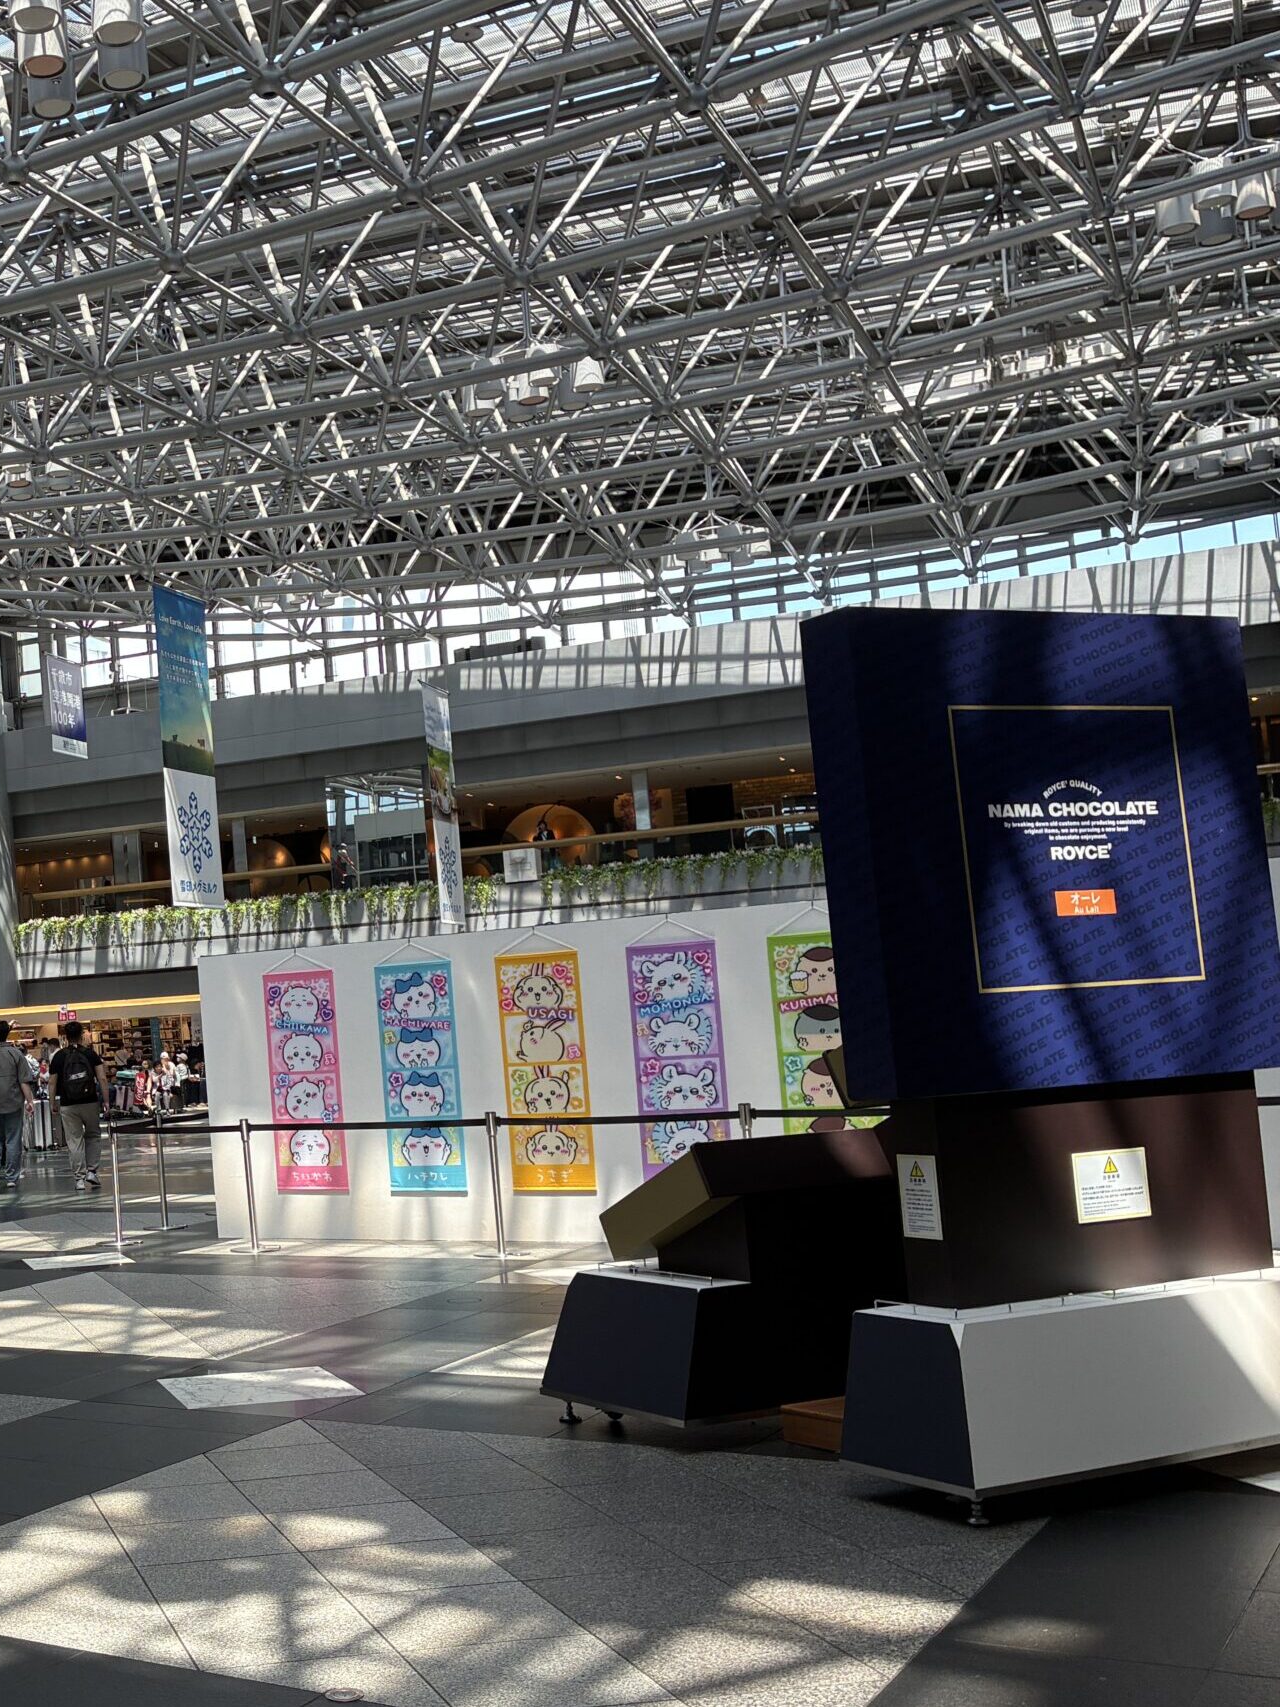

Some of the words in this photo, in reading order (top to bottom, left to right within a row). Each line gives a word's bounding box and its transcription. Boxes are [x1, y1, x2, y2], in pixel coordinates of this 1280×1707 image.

[1043, 779, 1068, 799] ROYCE'
[1070, 779, 1102, 797] QUALITY
[988, 803, 1044, 818] NAMA
[1048, 801, 1159, 817] CHOCOLATE
[1050, 842, 1112, 861] ROYCE'
[1070, 892, 1101, 905] オーレ
[640, 993, 710, 1016] MOMONGA
[780, 993, 838, 1012] KURIMA
[528, 1008, 572, 1019] USAGI
[276, 1018, 329, 1035] CHIIKAWA
[384, 1018, 450, 1030] HACHIWARE
[293, 1171, 332, 1182] ちいかわ
[408, 1171, 448, 1182] ハチワレ
[537, 1169, 574, 1183] うさぎ
